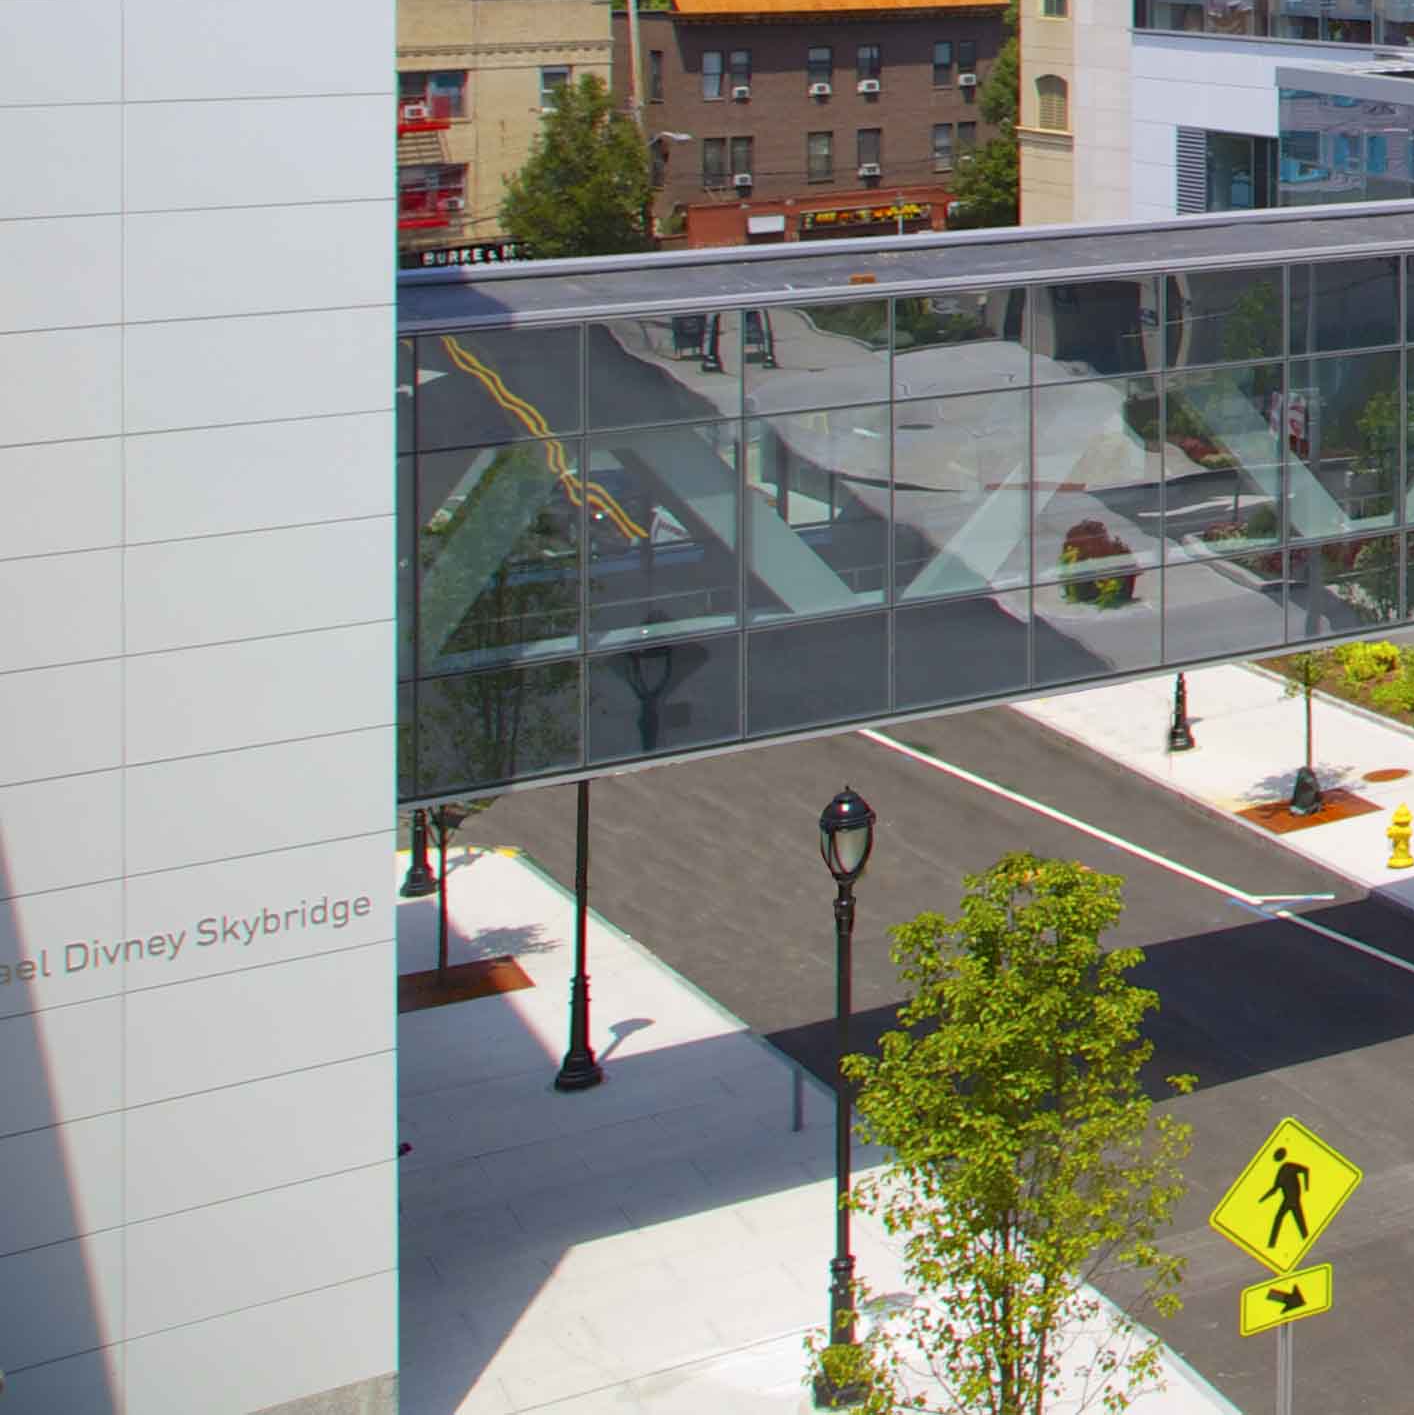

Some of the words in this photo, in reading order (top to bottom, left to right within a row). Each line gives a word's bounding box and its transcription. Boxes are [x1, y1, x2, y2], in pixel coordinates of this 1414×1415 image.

[422, 247, 484, 265] BURKE
[65, 930, 186, 973] Divney
[196, 895, 371, 946] Skybridge
